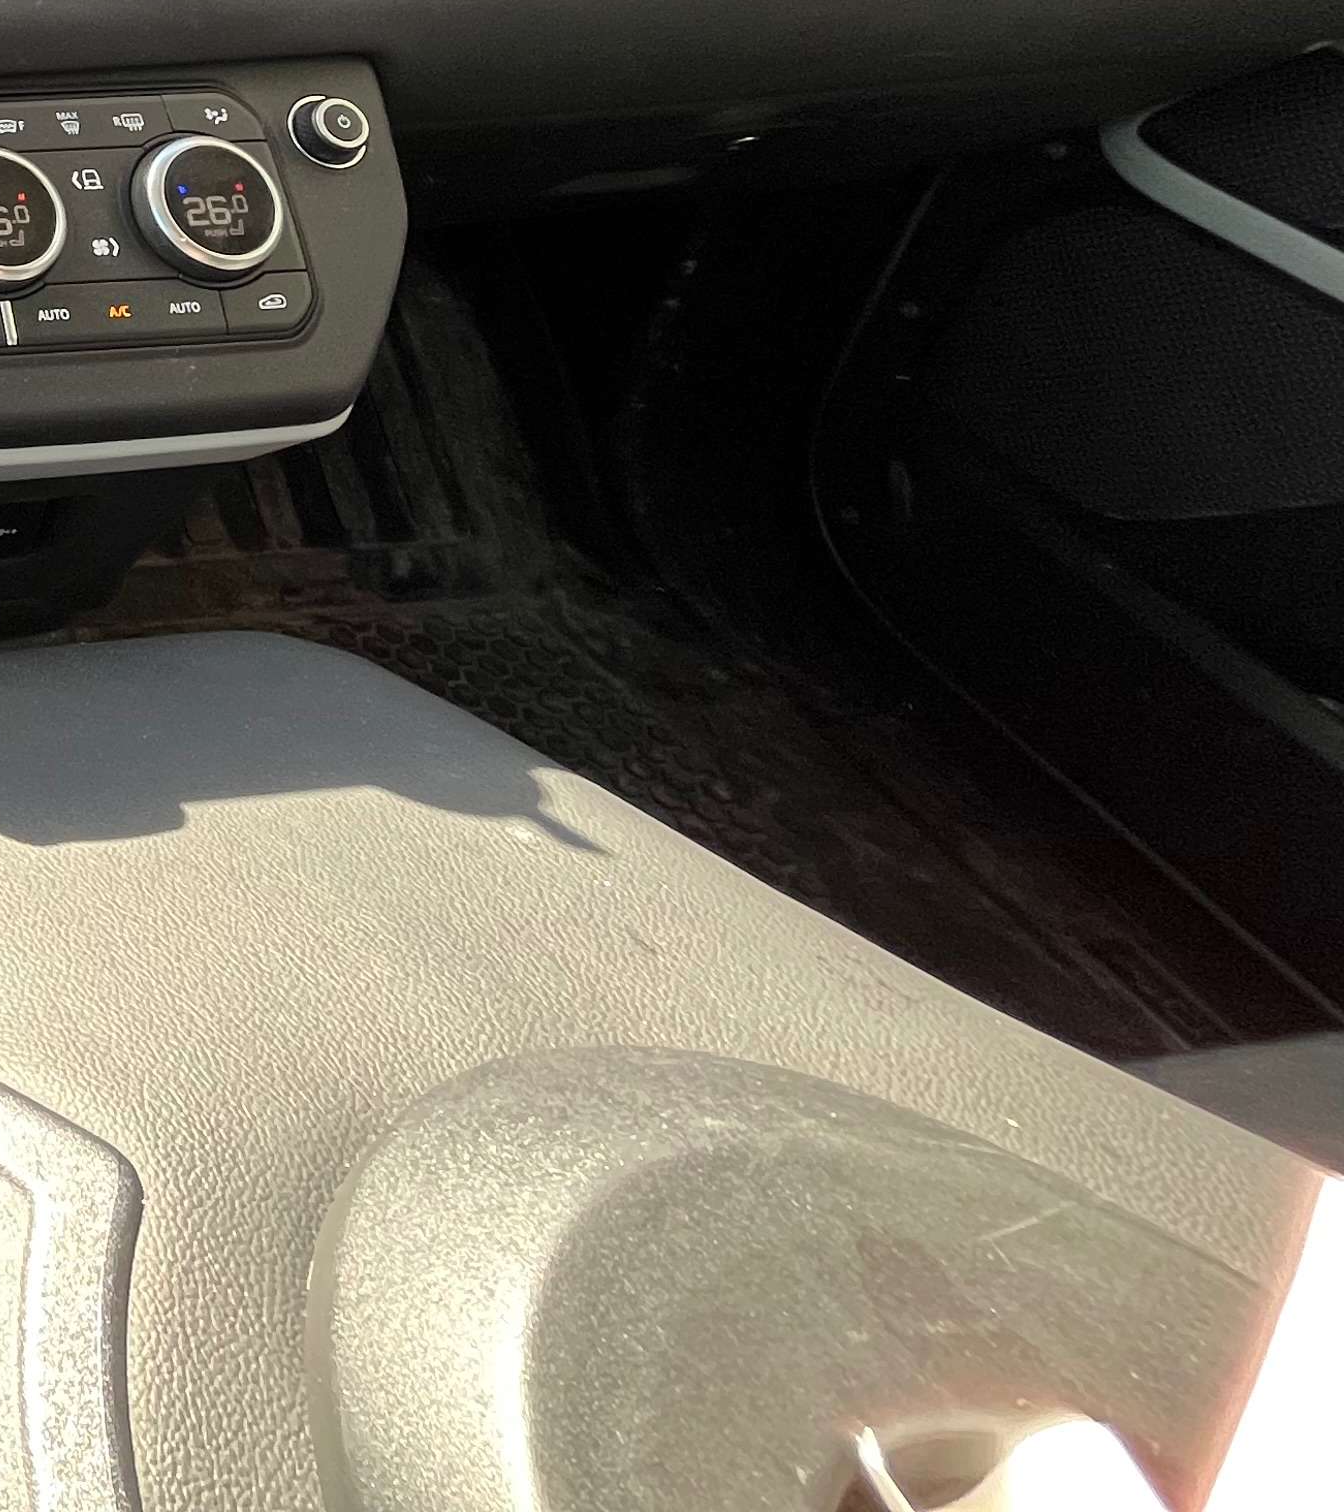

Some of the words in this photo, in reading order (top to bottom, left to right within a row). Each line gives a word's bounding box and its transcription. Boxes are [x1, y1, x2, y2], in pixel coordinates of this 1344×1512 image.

[55, 111, 79, 120] MAX
[112, 116, 122, 127] R
[18, 120, 25, 131] F
[109, 304, 133, 318] A/C
[169, 301, 202, 314] AUTO
[37, 308, 71, 322] AUTO
